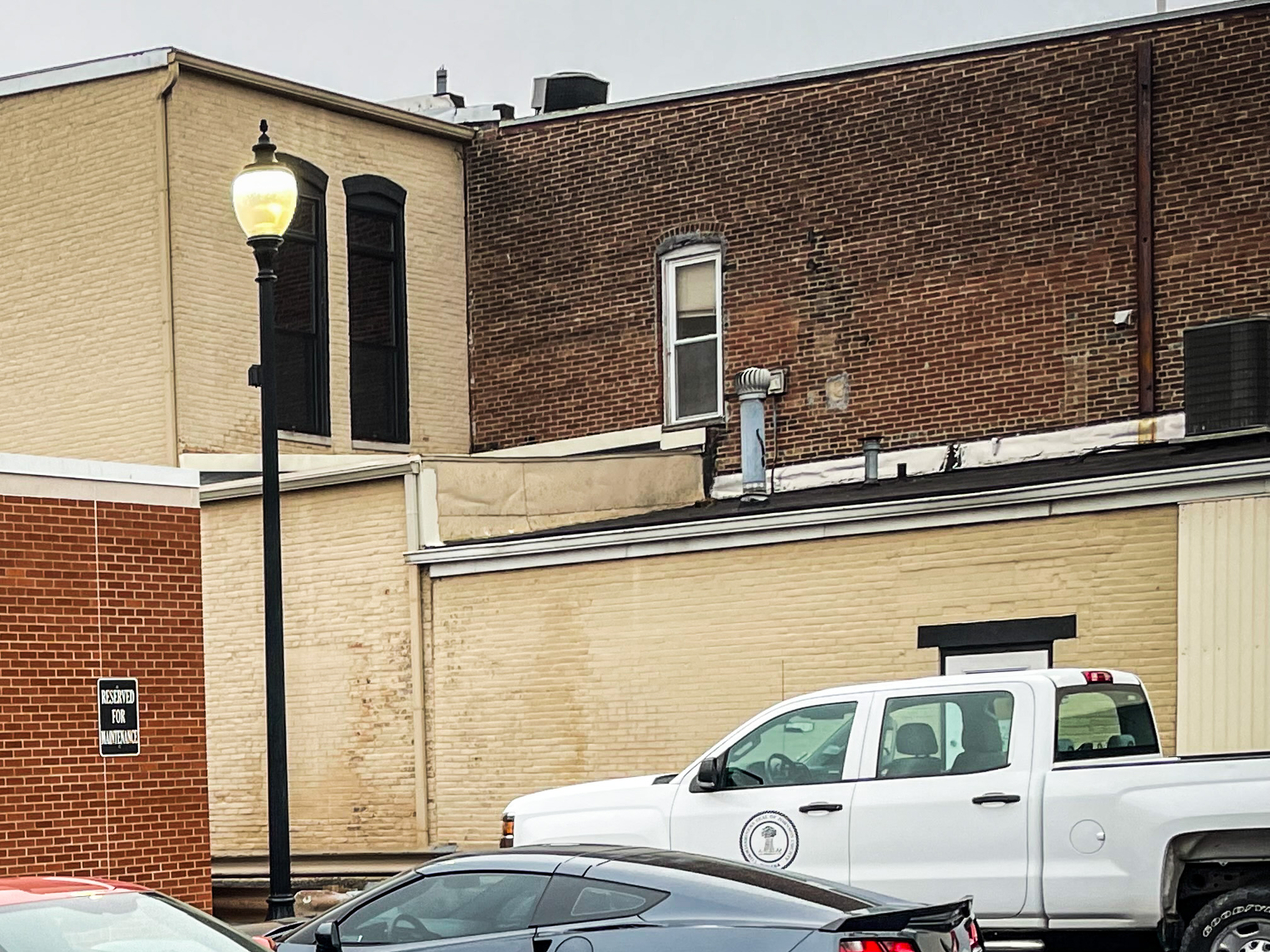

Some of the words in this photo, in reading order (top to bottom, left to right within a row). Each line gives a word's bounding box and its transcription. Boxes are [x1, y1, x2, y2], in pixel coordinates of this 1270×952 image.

[101, 689, 135, 704] RESERVED
[111, 709, 126, 724] FOR
[100, 729, 138, 745] MAINTENANCE
